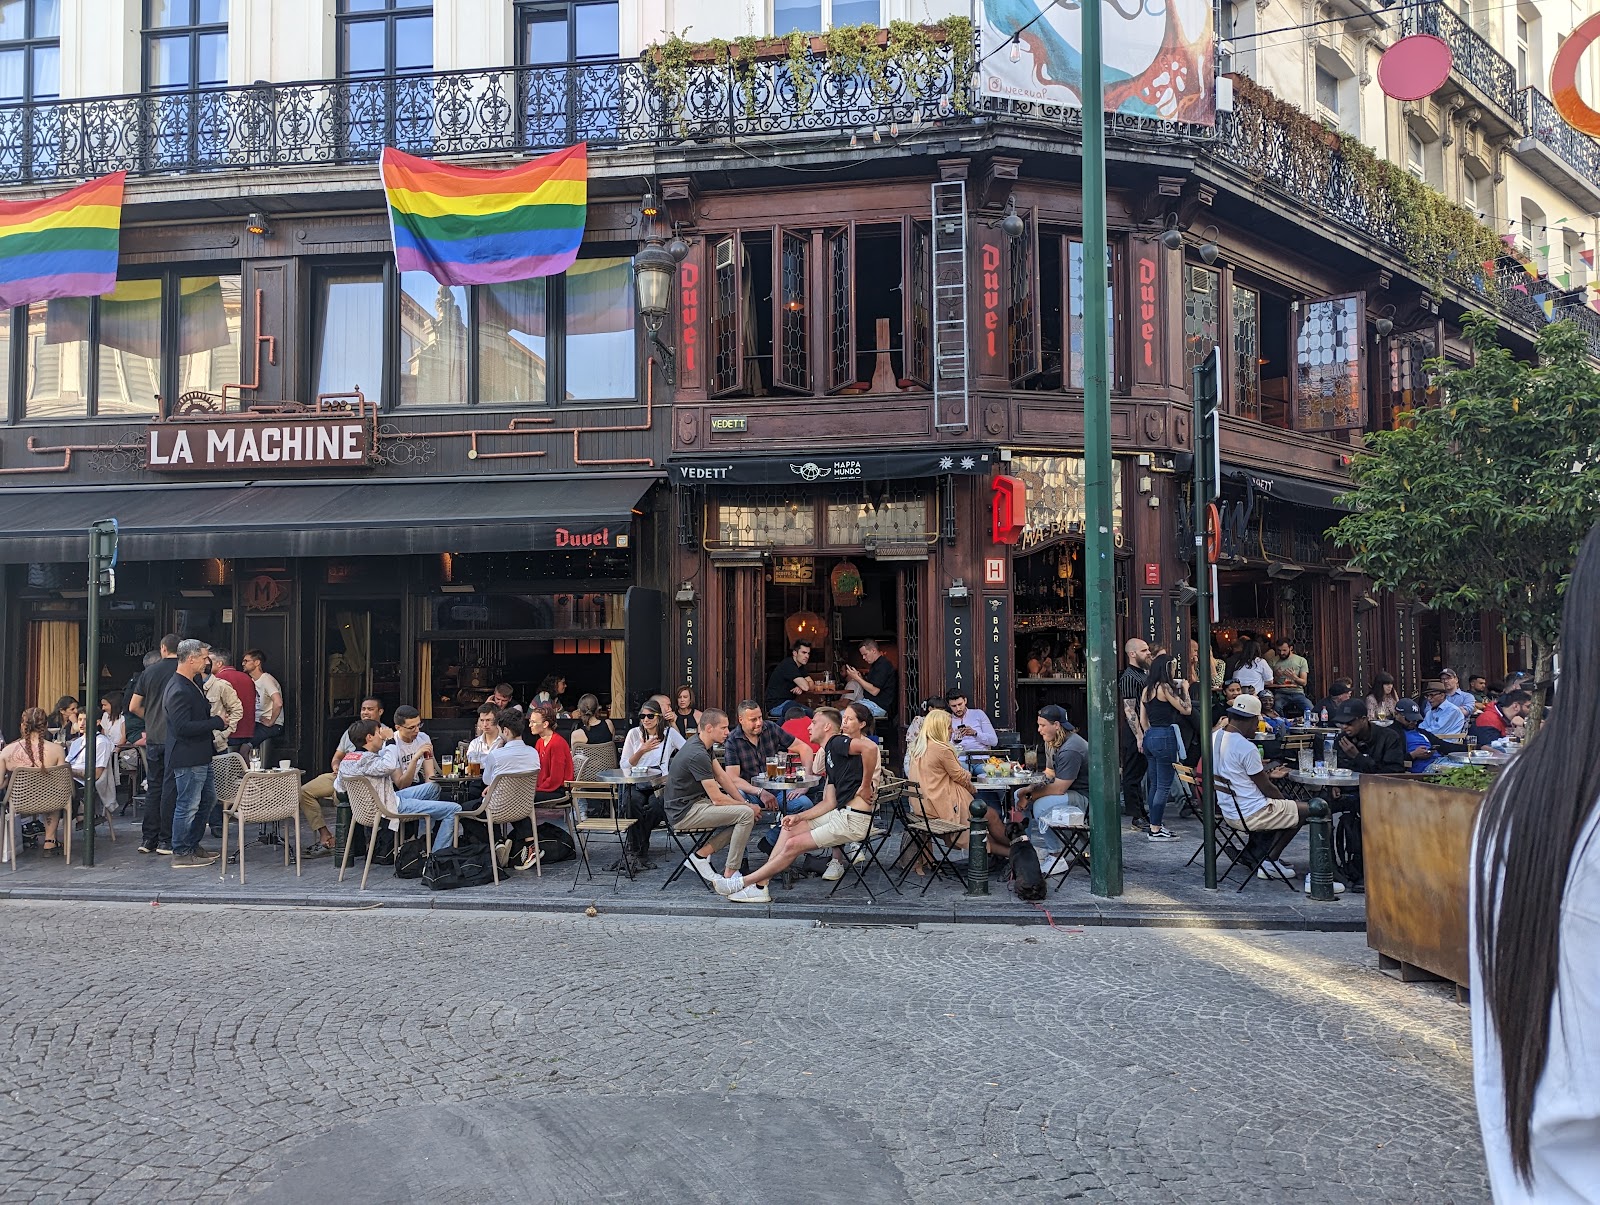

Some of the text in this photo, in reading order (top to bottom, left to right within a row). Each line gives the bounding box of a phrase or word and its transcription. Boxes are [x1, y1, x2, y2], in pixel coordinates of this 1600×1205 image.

[981, 243, 1000, 358] Duvel
[681, 262, 699, 371] Duvel
[1139, 257, 1155, 367] Duvel
[711, 419, 746, 429] VEDETT
[150, 425, 363, 465] LA MACHINE
[680, 466, 728, 479] VEDETT
[834, 460, 861, 469] MAPPA
[834, 467, 861, 476] MUNDO
[555, 527, 609, 547] Duvel
[989, 562, 1001, 579] H
[954, 616, 962, 689] COCKTAI
